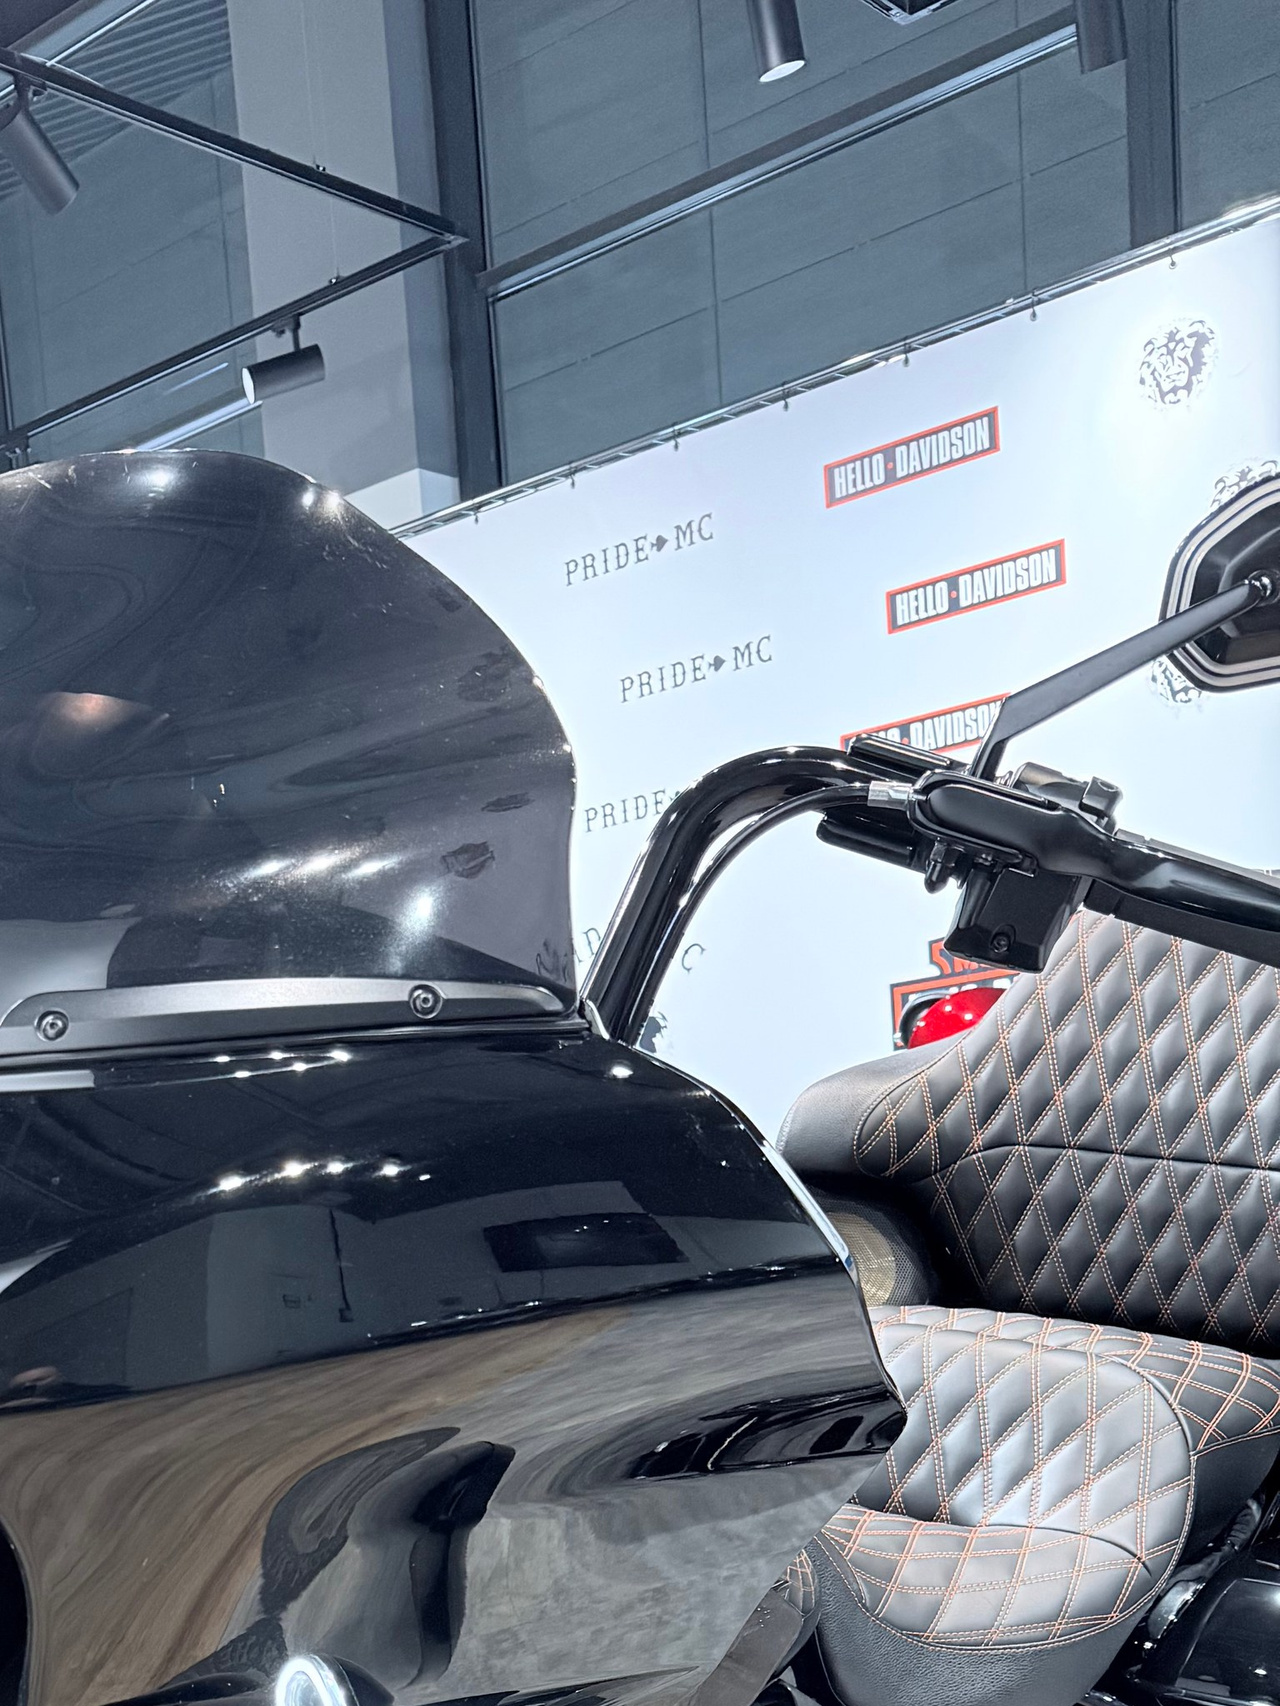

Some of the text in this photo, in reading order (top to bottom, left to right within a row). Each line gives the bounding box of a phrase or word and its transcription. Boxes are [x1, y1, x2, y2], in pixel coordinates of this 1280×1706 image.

[833, 416, 991, 499] HELLO DAVIDSON
[564, 512, 714, 587] PRIDE MC
[895, 548, 1057, 626] HELLO DAVIDSON
[619, 634, 773, 703] PRIDE MC
